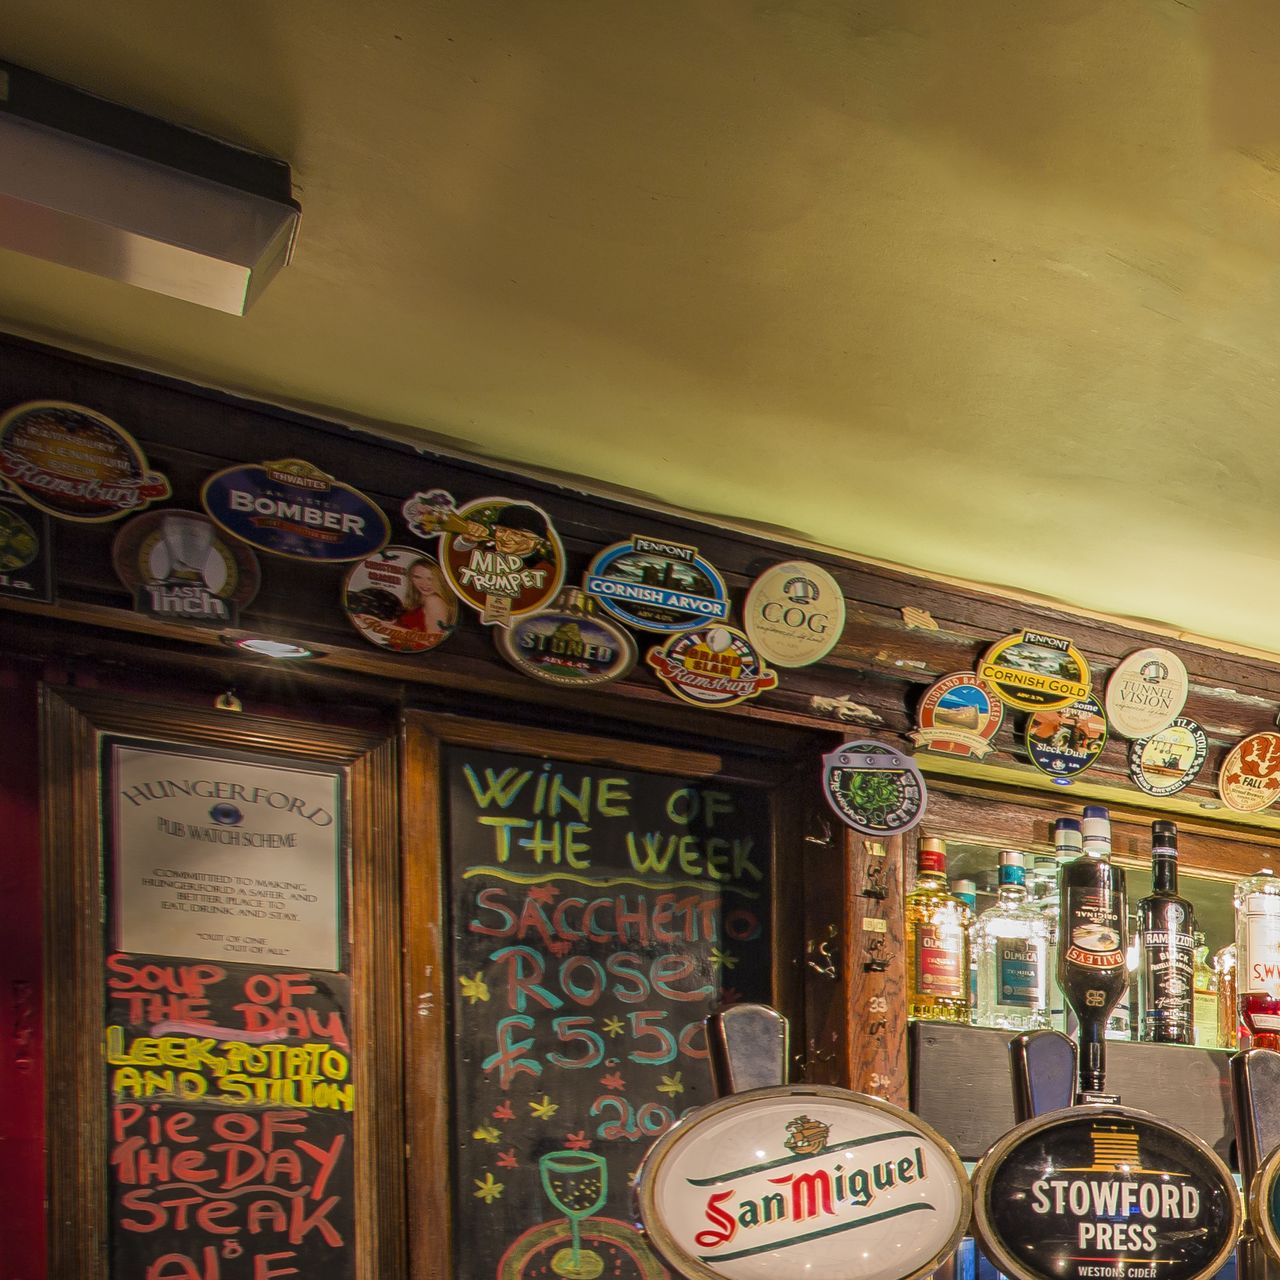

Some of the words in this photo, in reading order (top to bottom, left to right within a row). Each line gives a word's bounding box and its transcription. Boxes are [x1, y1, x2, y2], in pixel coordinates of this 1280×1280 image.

[8, 457, 139, 503] Ramsbury
[272, 471, 327, 490] THWAITES
[229, 489, 365, 536] BOMBER
[471, 550, 523, 573] MAD
[636, 540, 693, 560] PENPONT
[459, 567, 547, 595] TRUMPET
[590, 580, 663, 603] CORNISH
[666, 595, 723, 615] ARVOR
[761, 601, 829, 634] COG
[1025, 632, 1069, 651] PENPONT
[668, 664, 755, 696] Ramsbury
[925, 677, 960, 710] STUDLAND
[983, 666, 1046, 689] CORNISH
[1049, 680, 1086, 697] GOLD
[1122, 679, 1175, 700] TUNNEL
[1119, 690, 1172, 709] VISION
[1036, 743, 1063, 758] Sleck
[1064, 747, 1088, 759] Dust
[1194, 730, 1207, 759] STOUT
[1242, 777, 1264, 789] FALL
[121, 780, 333, 827] HUNGERFORD
[666, 787, 736, 830] OF
[157, 817, 185, 838] PUB
[189, 824, 240, 847] WATCH
[243, 832, 298, 849] SCHEME
[477, 816, 594, 870] THE
[626, 830, 763, 882] WEEK
[141, 878, 235, 895] HUNGERFORD
[249, 889, 285, 900] SAFER
[289, 893, 318, 904] AND
[153, 868, 232, 884] COMMITTED
[255, 879, 307, 891] MAKING
[177, 892, 223, 904] BETTER
[226, 896, 263, 908] PLACE
[190, 904, 234, 915] DRINK
[237, 907, 266, 919] AND
[468, 887, 763, 947] SACCHETTO
[1004, 950, 1038, 962] OLMECA
[1069, 947, 1123, 967] BAILEYS
[107, 953, 227, 998] SOUP
[244, 973, 317, 1008] OF
[111, 991, 218, 1026] THE
[113, 1067, 209, 1100] AND
[218, 1074, 355, 1113] STILTON
[213, 1110, 310, 1152] OF
[208, 1135, 346, 1200] DAY
[1031, 1179, 1200, 1219] STOWFORD
[1078, 1221, 1159, 1253] PRESS
[1078, 1264, 1125, 1279] WESTONS
[1127, 1265, 1158, 1280] CIDER
